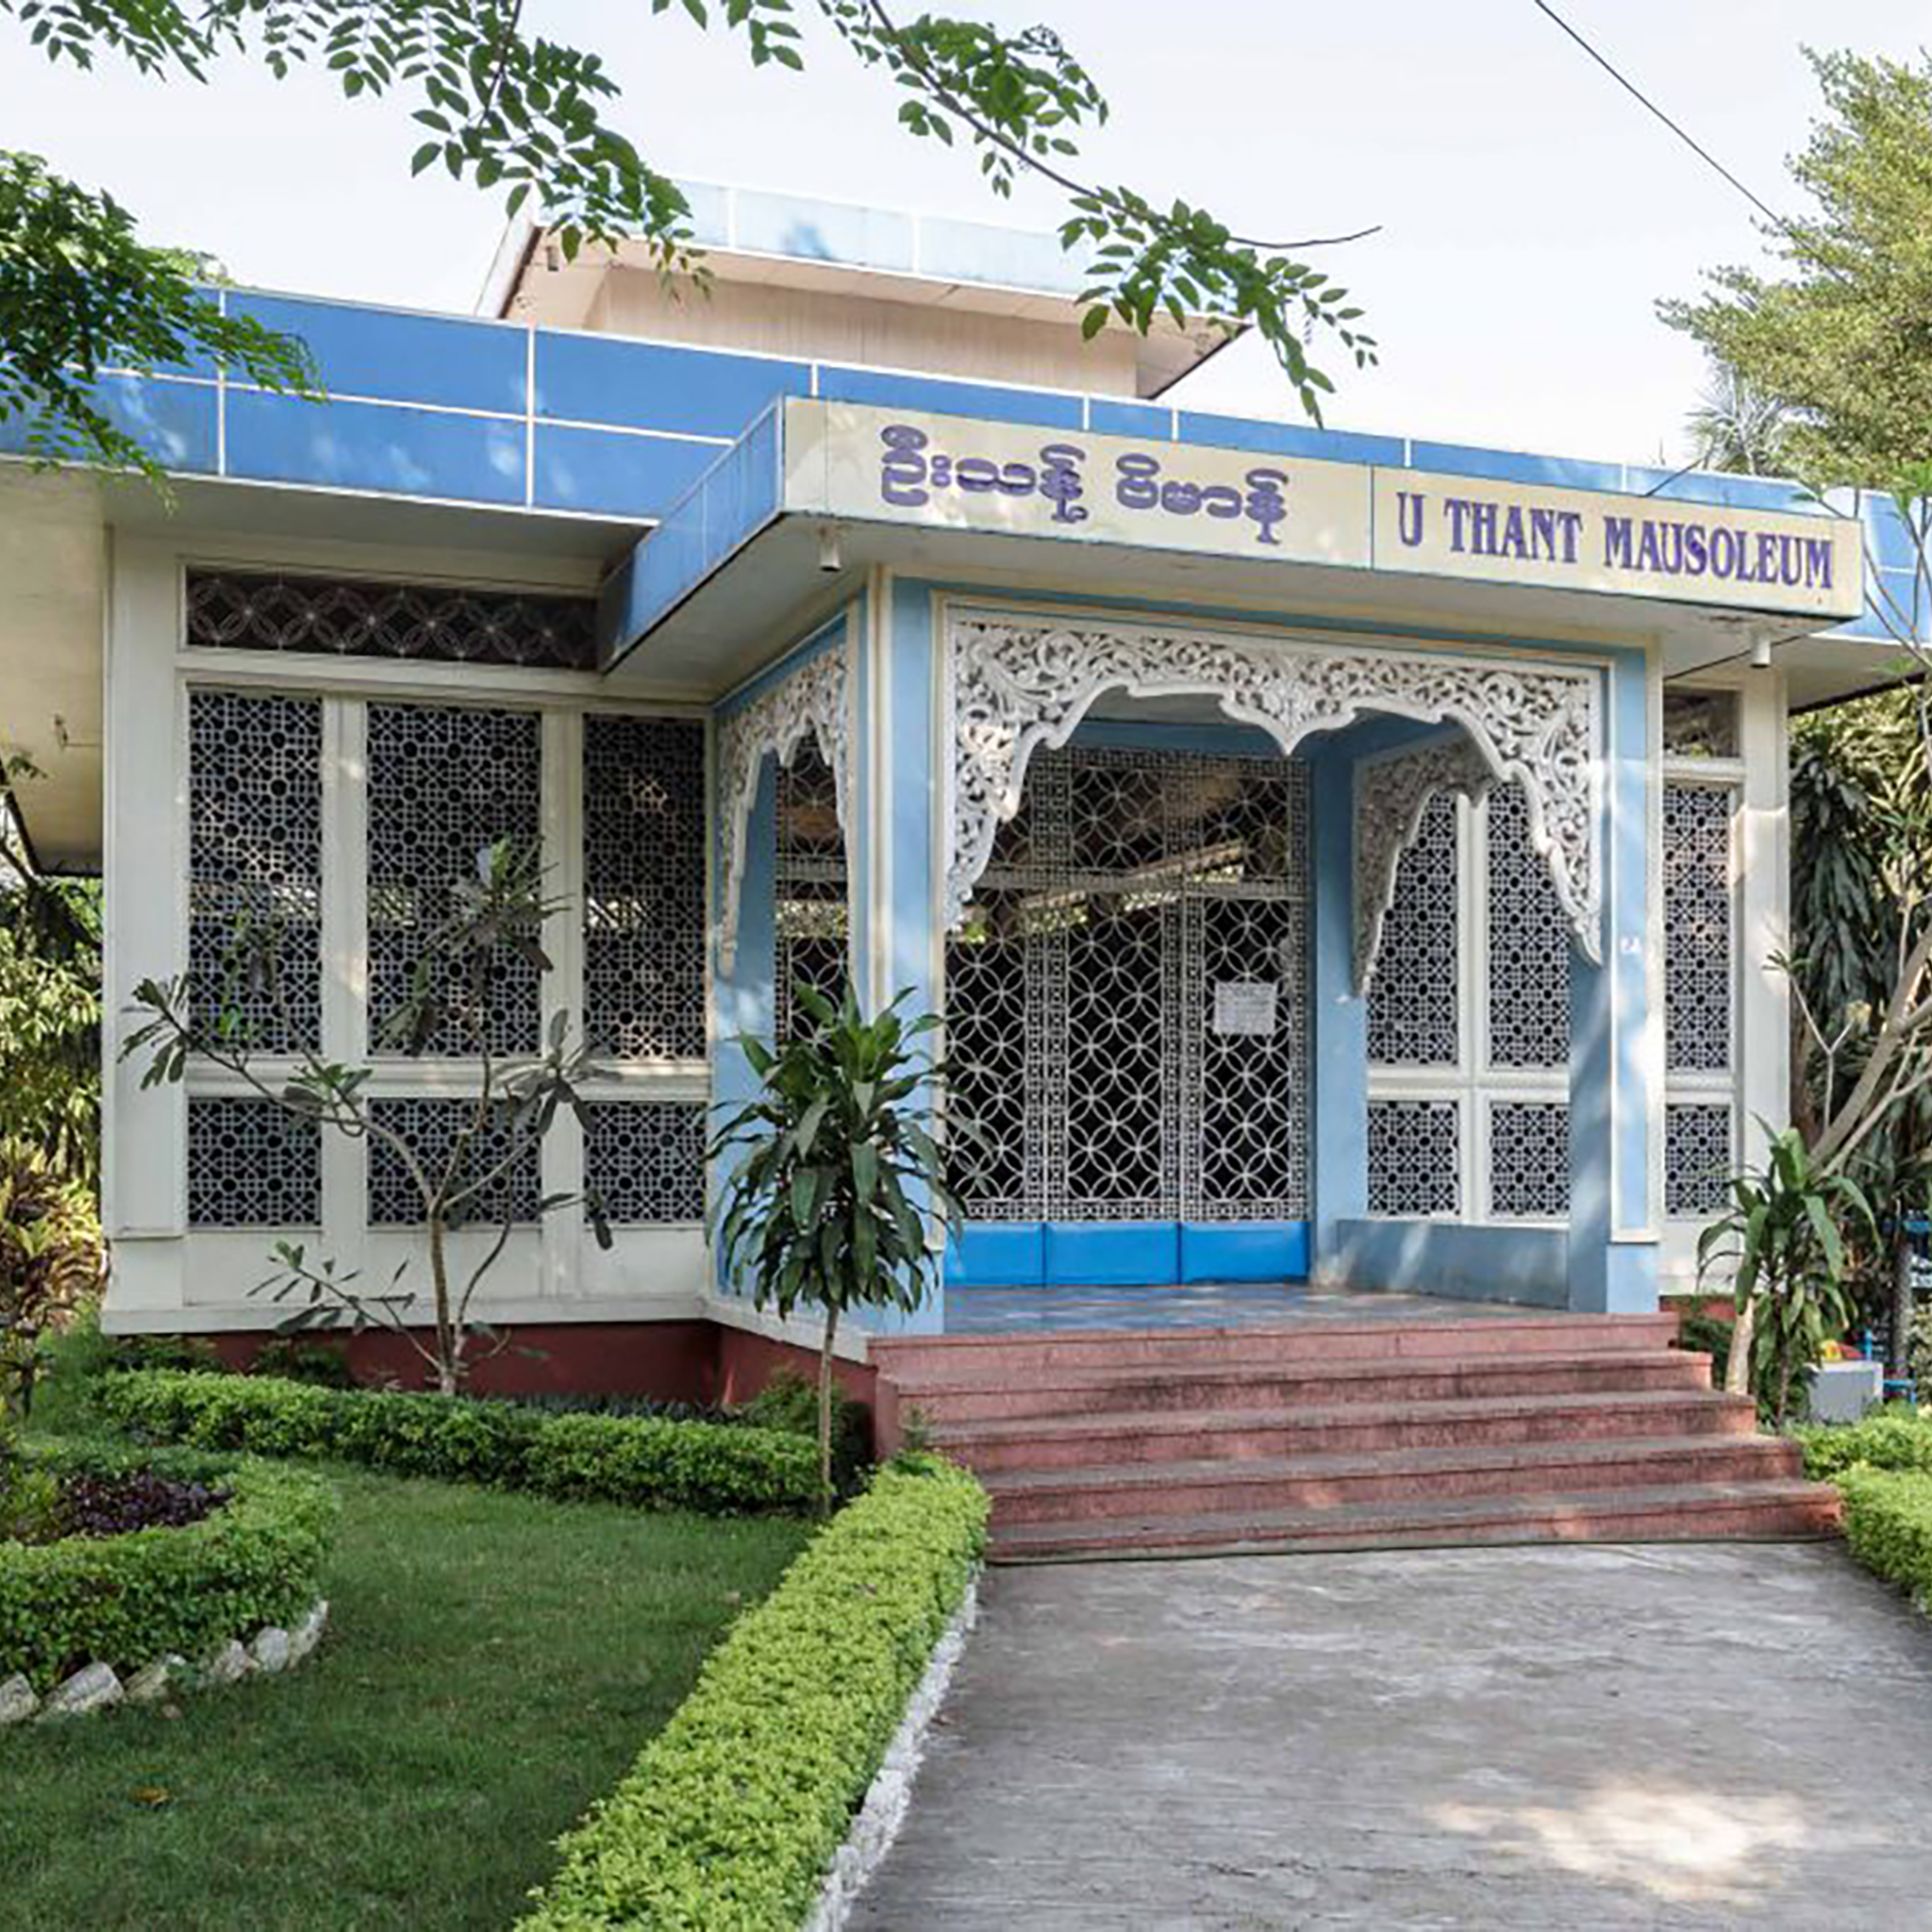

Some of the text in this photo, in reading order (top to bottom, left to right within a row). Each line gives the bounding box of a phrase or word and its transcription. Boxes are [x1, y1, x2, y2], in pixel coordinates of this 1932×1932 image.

[1397, 492, 1833, 590] U THANT MAUSOLEUM
